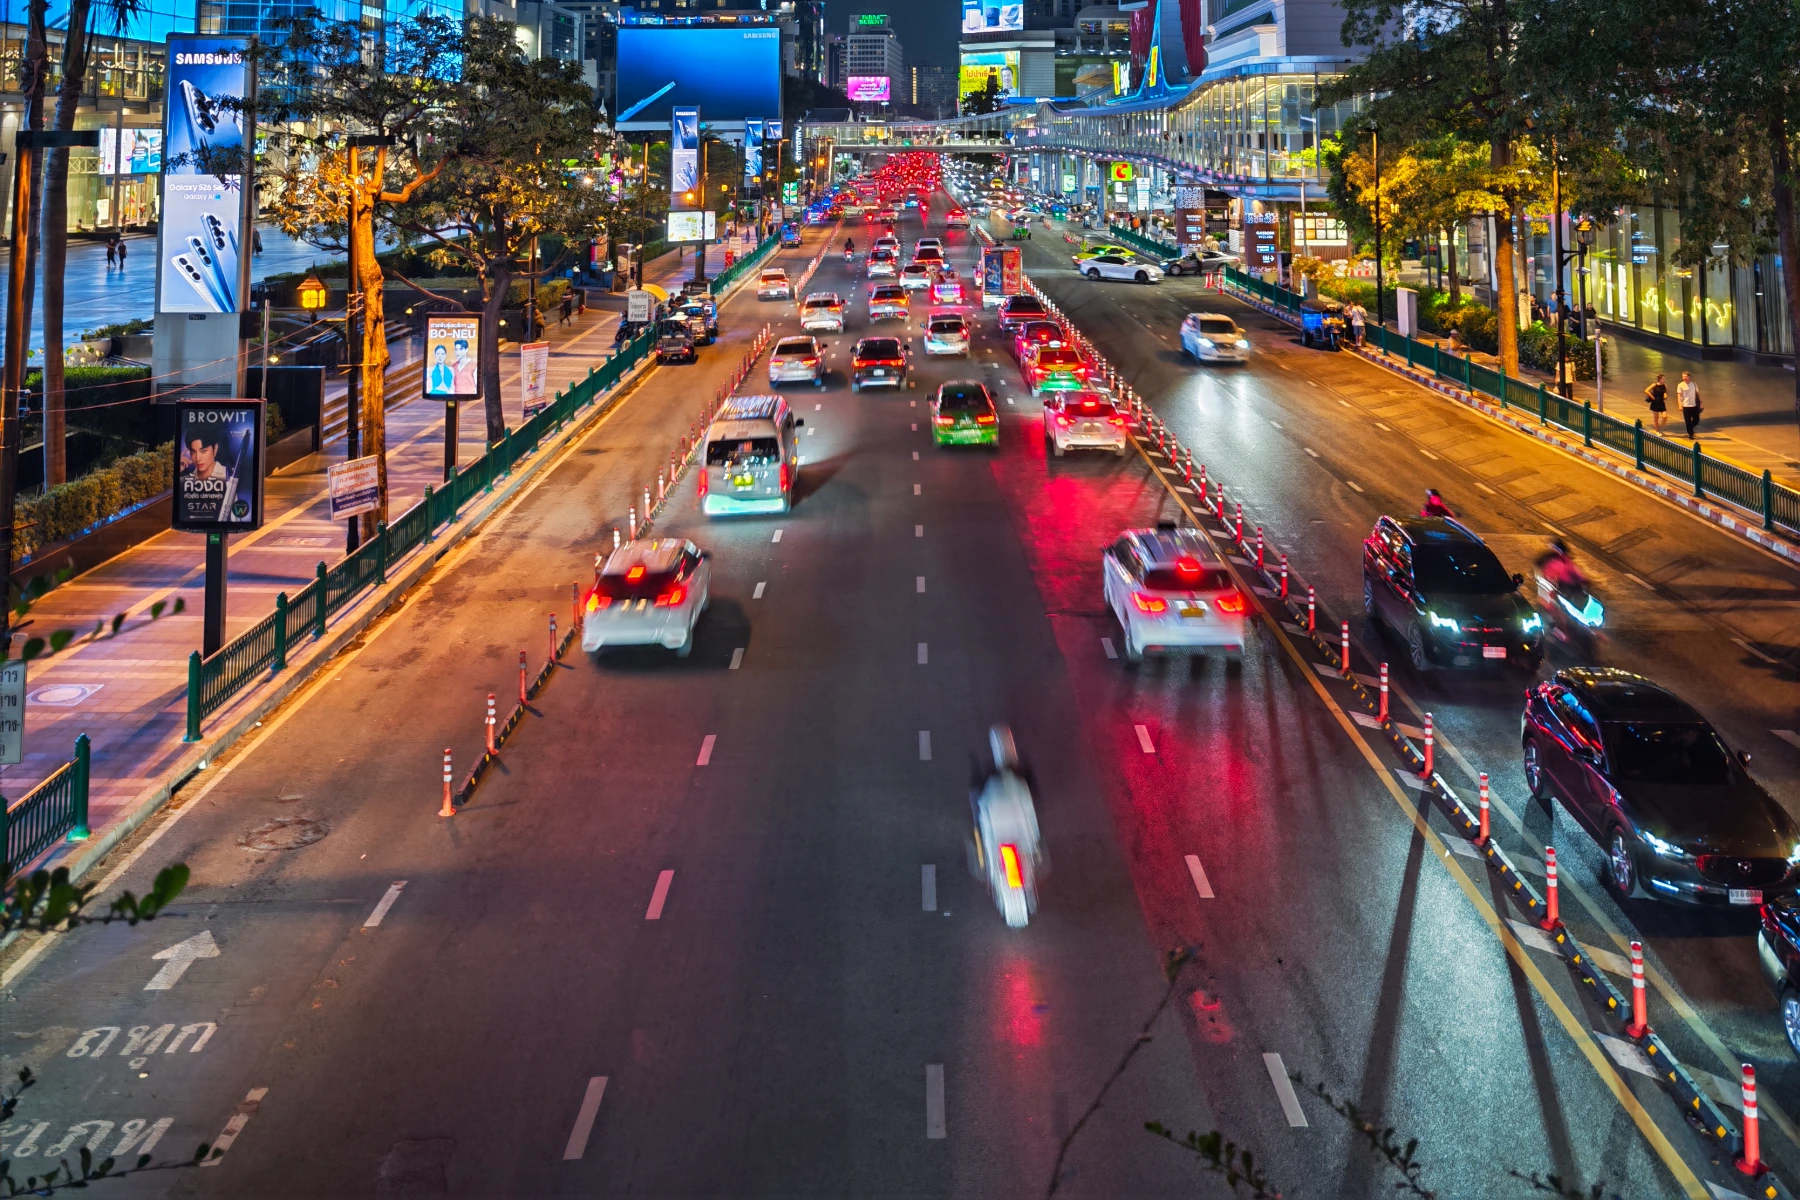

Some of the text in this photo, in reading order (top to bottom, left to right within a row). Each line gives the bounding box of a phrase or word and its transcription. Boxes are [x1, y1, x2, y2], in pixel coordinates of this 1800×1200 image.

[169, 184, 198, 192] Galaxy
[183, 193, 208, 201] Galaxy
[430, 329, 476, 339] BO-NEU
[189, 412, 247, 422] BROWIT
[184, 473, 224, 492] คิ้วงัด
[187, 502, 217, 510] STAR
